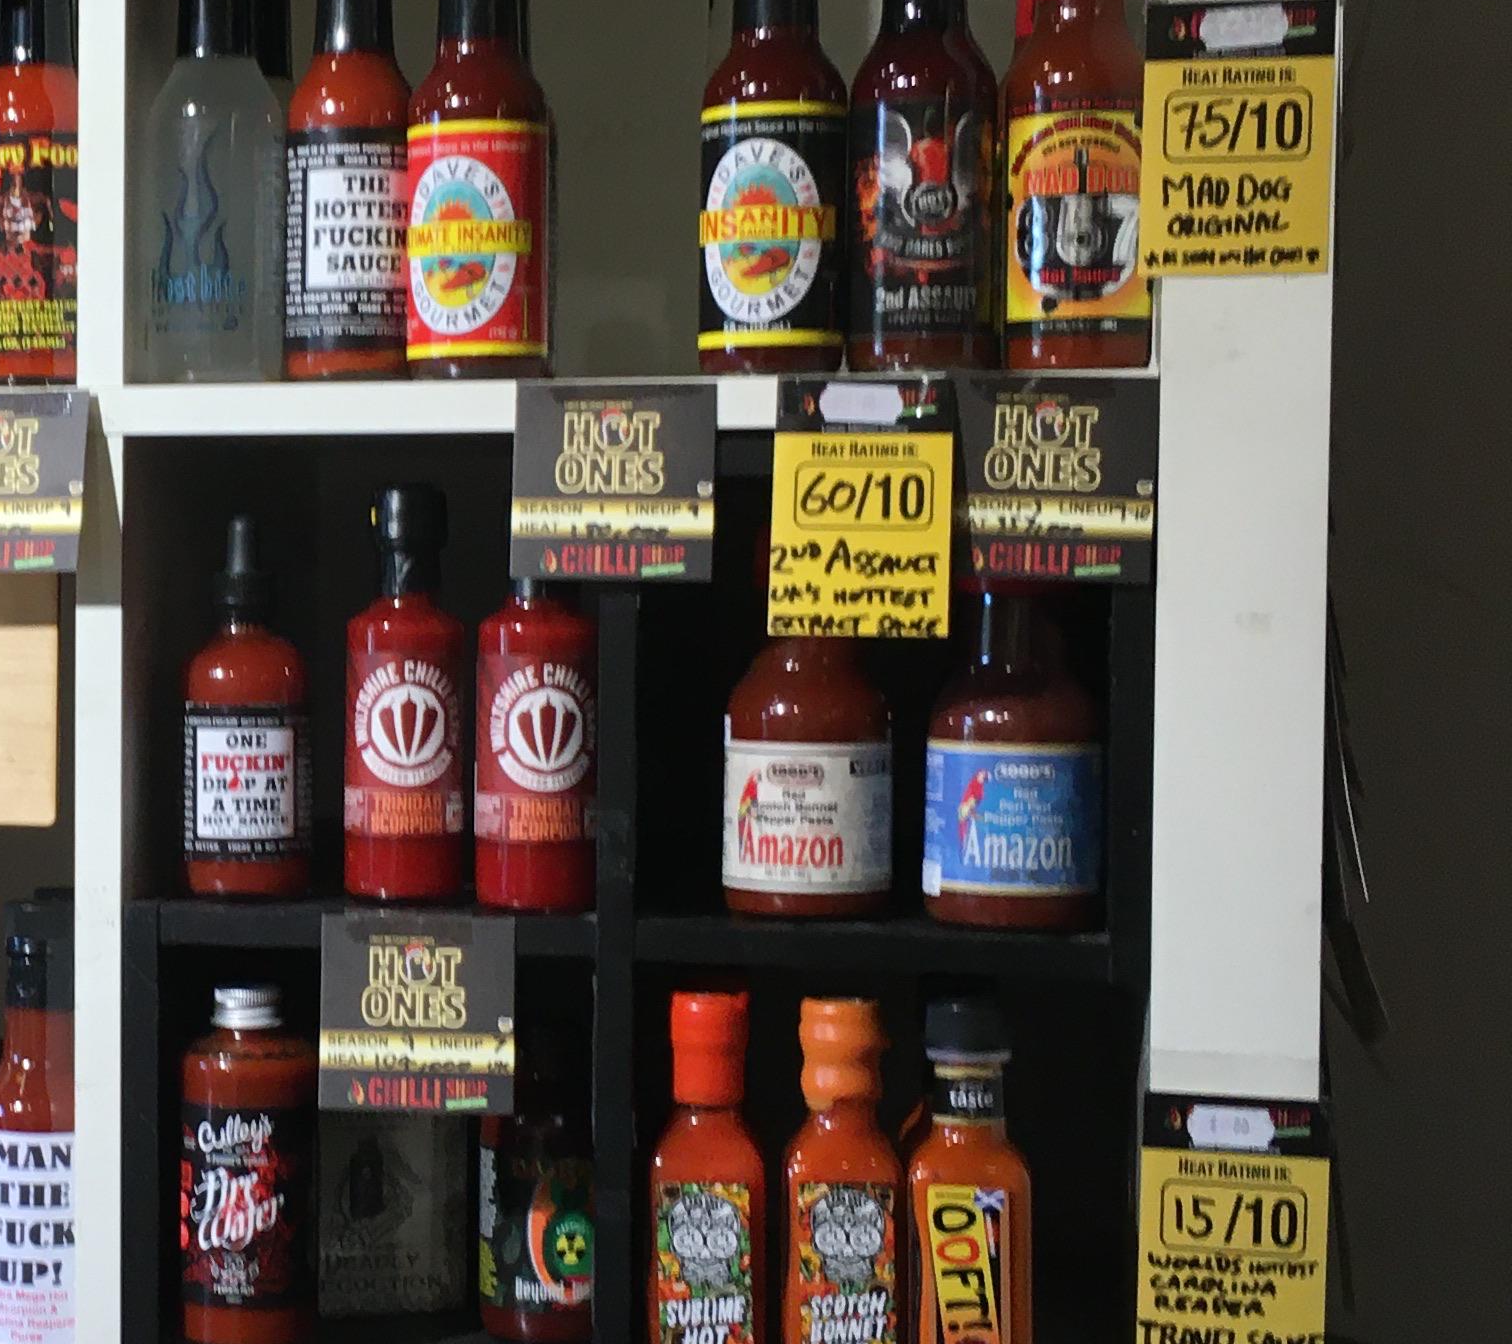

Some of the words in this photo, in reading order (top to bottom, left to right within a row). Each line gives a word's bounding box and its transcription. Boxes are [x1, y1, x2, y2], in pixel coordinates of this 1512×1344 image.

[1168, 96, 1303, 150] 75/10
[342, 175, 390, 193] THE
[1023, 171, 1077, 194] MAD
[1161, 176, 1230, 208] MAD
[1237, 174, 1291, 203] DOG
[456, 223, 530, 243] INSANITY
[701, 208, 828, 242] INSANITY
[327, 254, 401, 272] SAUCE
[709, 268, 811, 317] GOURMET
[563, 410, 660, 452] HOT
[994, 404, 1098, 451] HOT
[555, 452, 665, 495] ONES
[984, 448, 1100, 491] ONES
[800, 473, 925, 522] 60/10
[561, 546, 637, 575] CHILLI
[990, 546, 1069, 575] CHILLI
[225, 734, 267, 749] ONE
[234, 796, 280, 812] TIME
[741, 824, 843, 868] Amazon
[963, 820, 1072, 869] Amazon
[369, 945, 462, 986] HOT
[362, 986, 466, 1029] ONES
[368, 1078, 441, 1108] CHILLI
[667, 1296, 744, 1325] SUBLIME
[810, 1291, 886, 1317] SCOTCH
